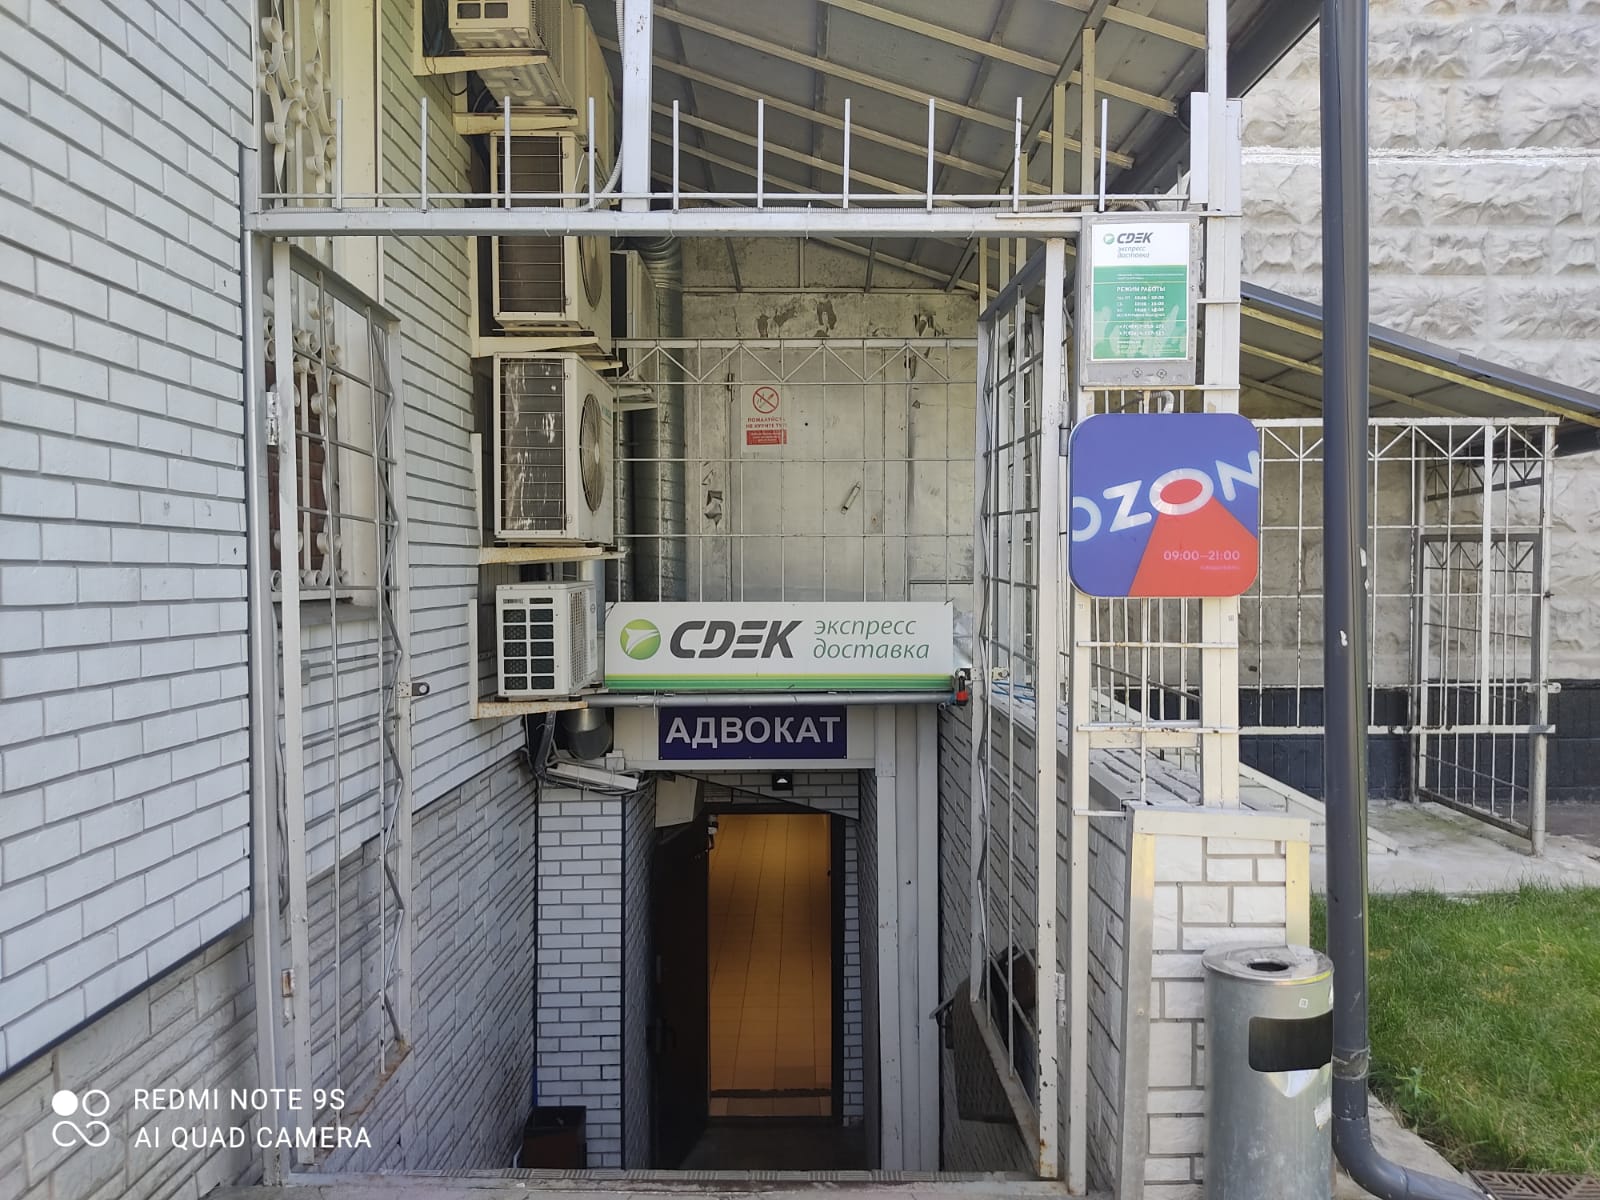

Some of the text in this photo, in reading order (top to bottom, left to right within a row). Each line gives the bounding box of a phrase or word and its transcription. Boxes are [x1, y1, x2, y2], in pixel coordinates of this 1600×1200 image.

[1117, 232, 1153, 244] CDEK
[1072, 450, 1259, 542] OZON
[670, 620, 804, 659] CDEK
[814, 620, 917, 639] экспресс
[813, 638, 930, 659] доставка
[665, 716, 841, 749] АДВОКАТ
